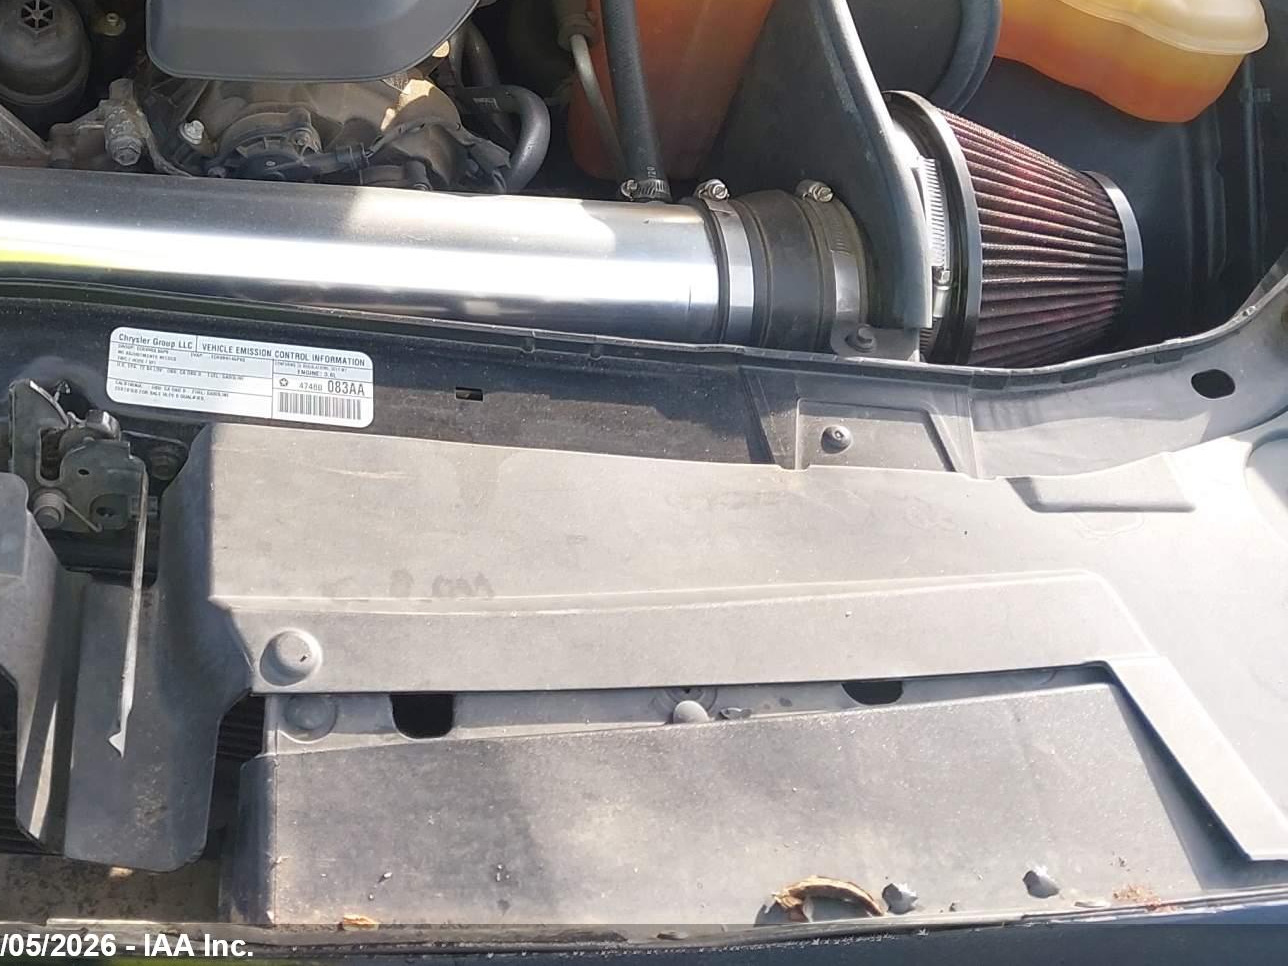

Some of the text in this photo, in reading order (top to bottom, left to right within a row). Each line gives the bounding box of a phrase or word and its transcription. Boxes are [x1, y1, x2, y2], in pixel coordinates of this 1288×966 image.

[118, 333, 150, 345] Chrysler
[153, 337, 175, 350] Group
[178, 341, 193, 349] LLC
[202, 343, 233, 354] VEHICLE
[235, 346, 272, 357] EMISSION
[274, 350, 309, 362] CONTROL
[312, 354, 365, 366] INFORMATION
[327, 380, 366, 396] 083AA
